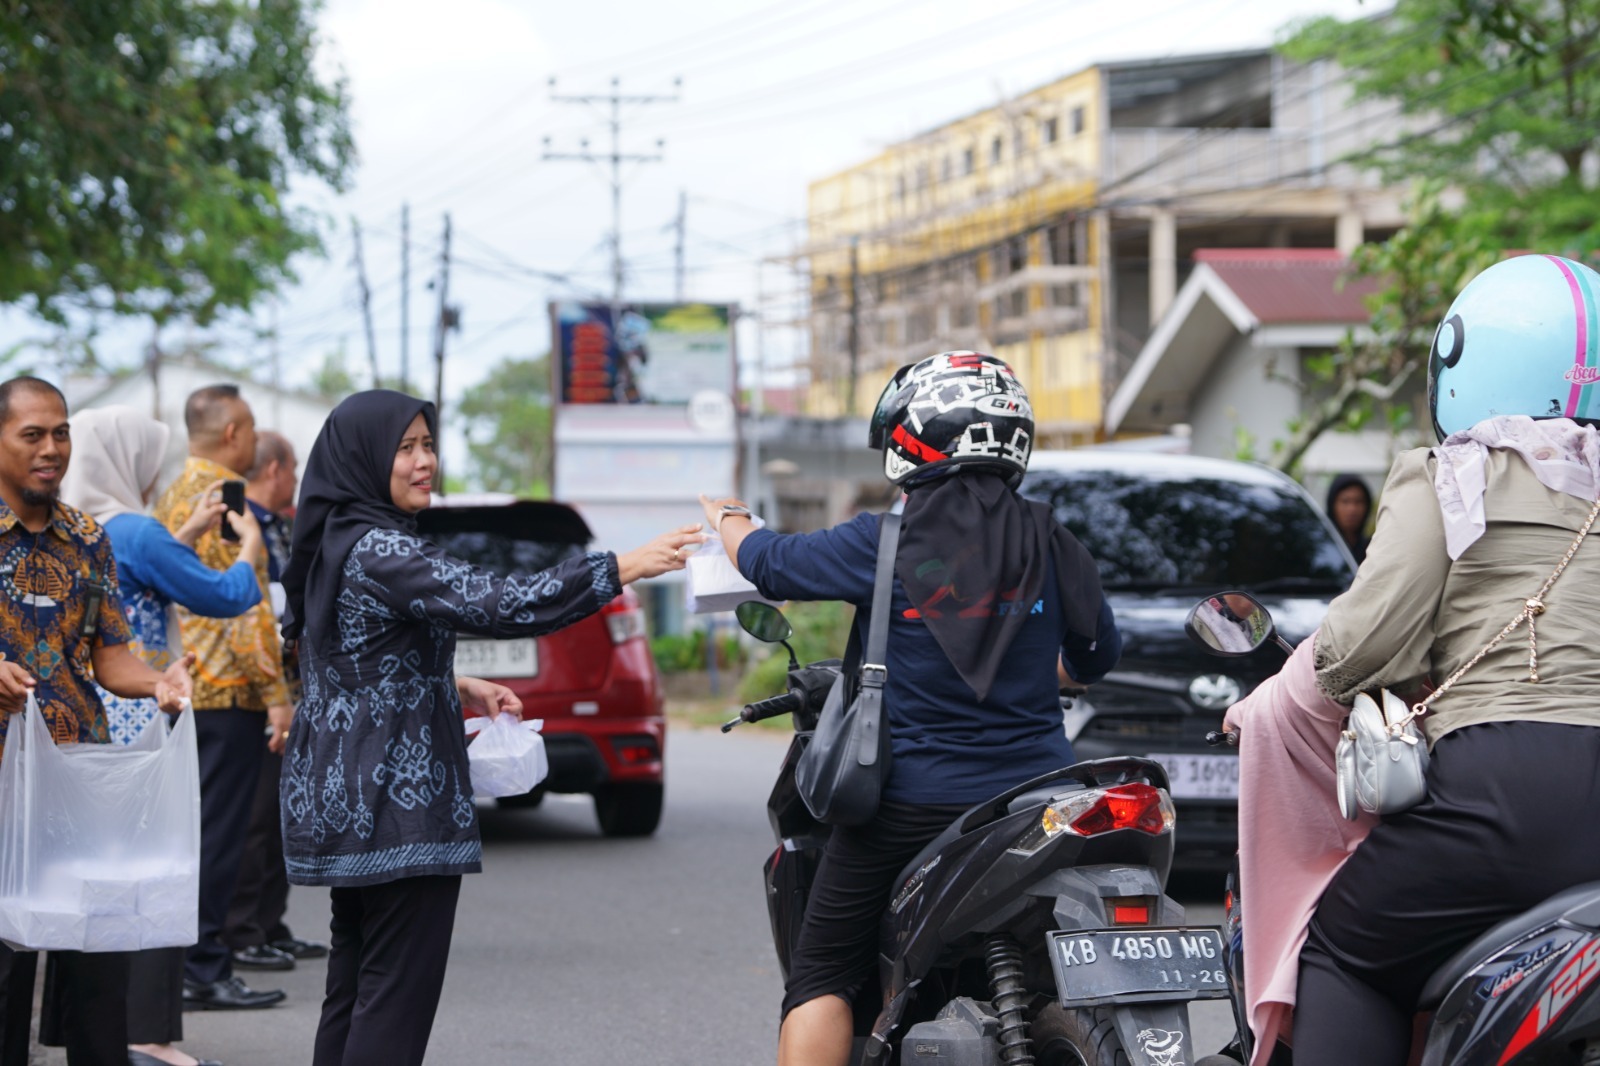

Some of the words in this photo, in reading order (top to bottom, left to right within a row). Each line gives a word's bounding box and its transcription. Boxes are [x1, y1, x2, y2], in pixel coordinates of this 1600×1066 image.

[991, 397, 1020, 413] GM
[1060, 939, 1097, 966] KB
[1112, 937, 1173, 960] 4850
[1179, 936, 1216, 959] MG
